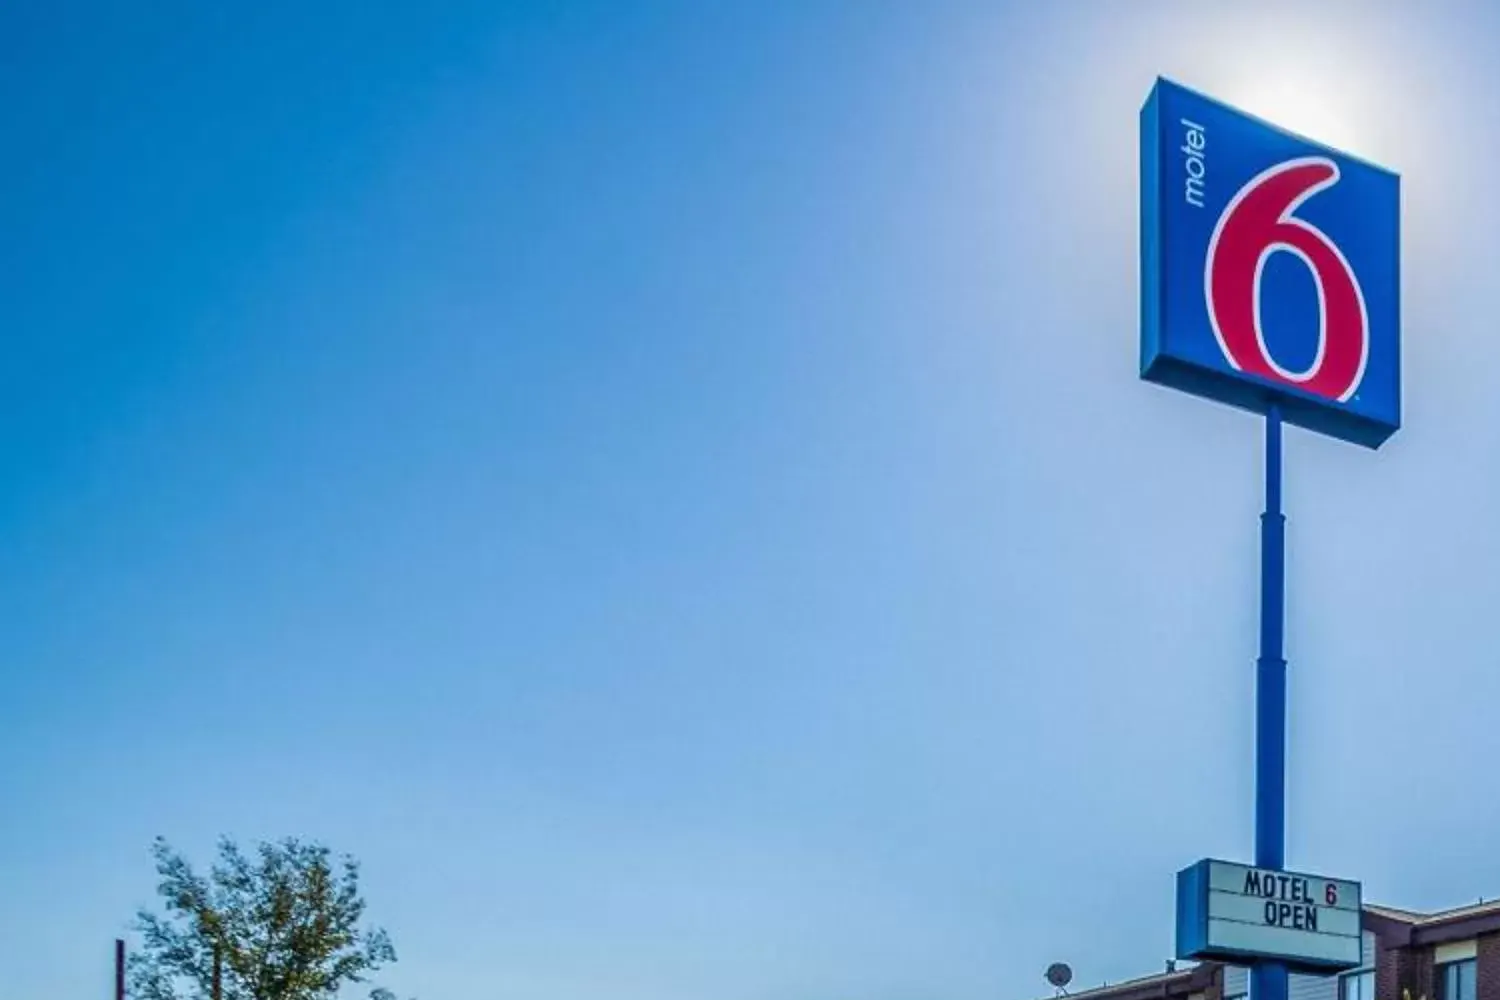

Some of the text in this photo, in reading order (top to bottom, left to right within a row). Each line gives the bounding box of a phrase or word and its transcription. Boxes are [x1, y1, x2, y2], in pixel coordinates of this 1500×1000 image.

[1181, 119, 1205, 208] motel
[1204, 156, 1369, 403] 6
[1245, 871, 1338, 905] MOTEL 6
[1265, 902, 1317, 930] OPEN
